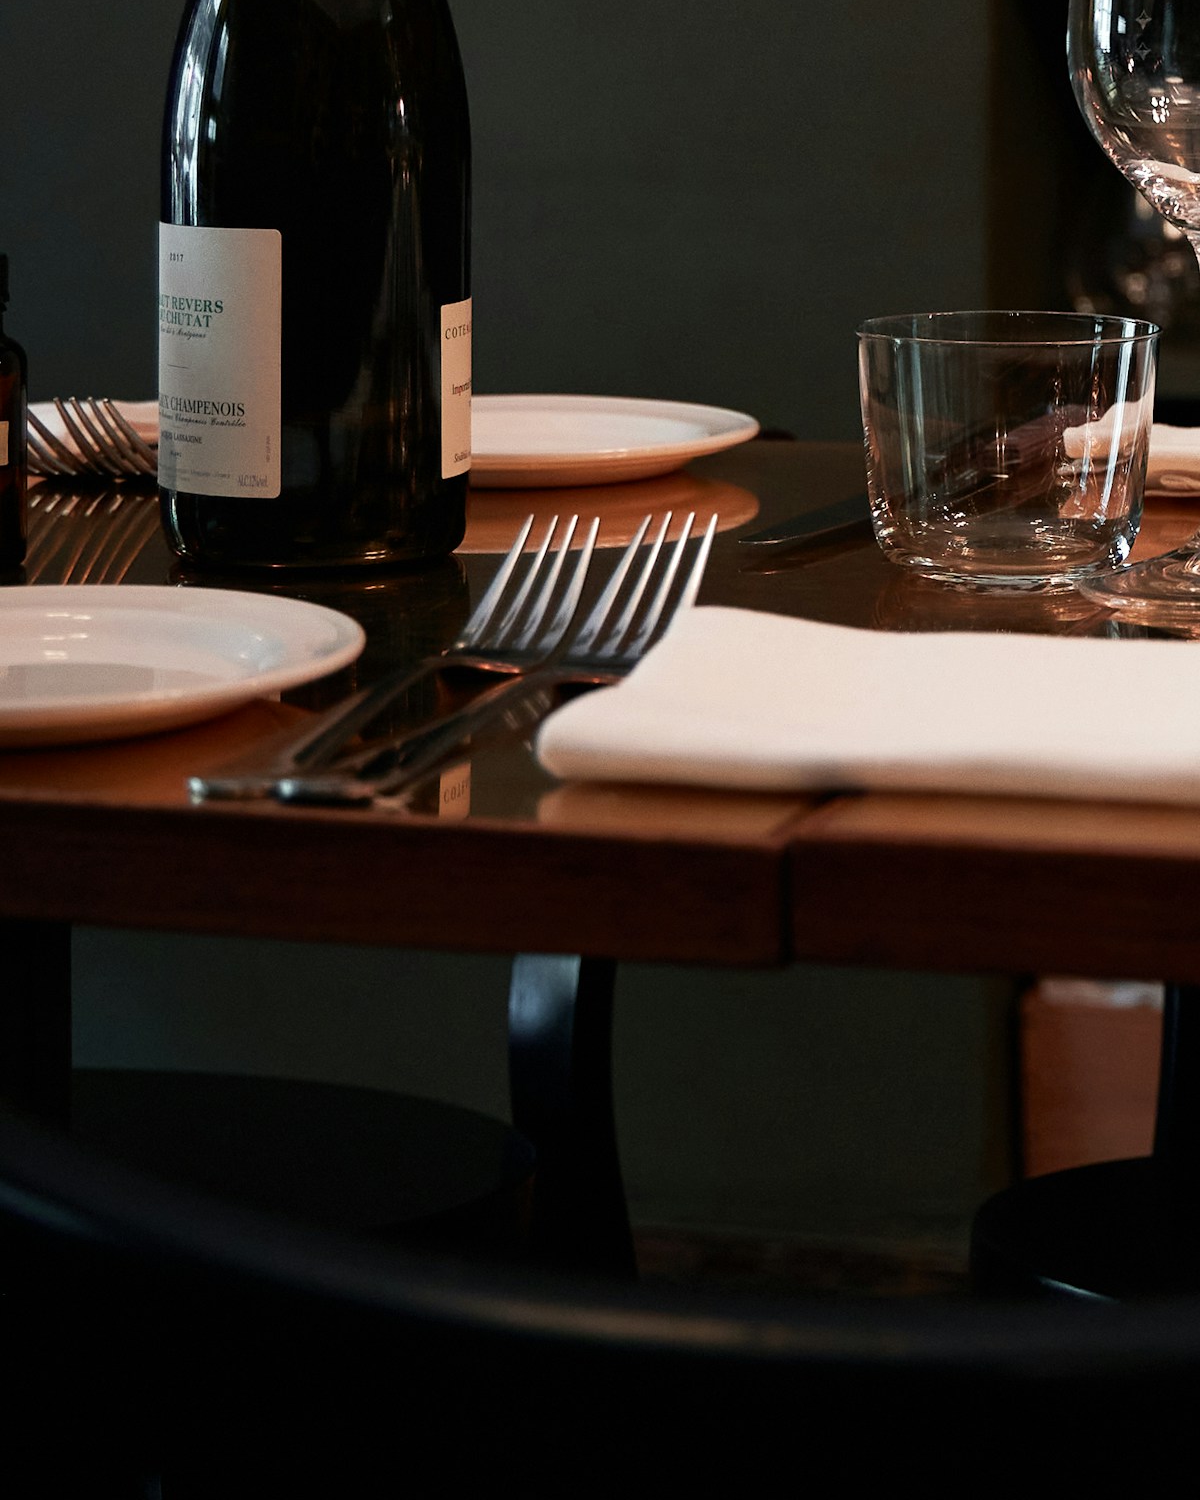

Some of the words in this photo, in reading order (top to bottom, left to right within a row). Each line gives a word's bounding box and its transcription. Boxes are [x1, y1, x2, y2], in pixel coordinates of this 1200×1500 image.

[172, 296, 224, 314] REVERS
[166, 310, 213, 328] CHUTAT
[170, 396, 245, 417] CHAMPENOIS
